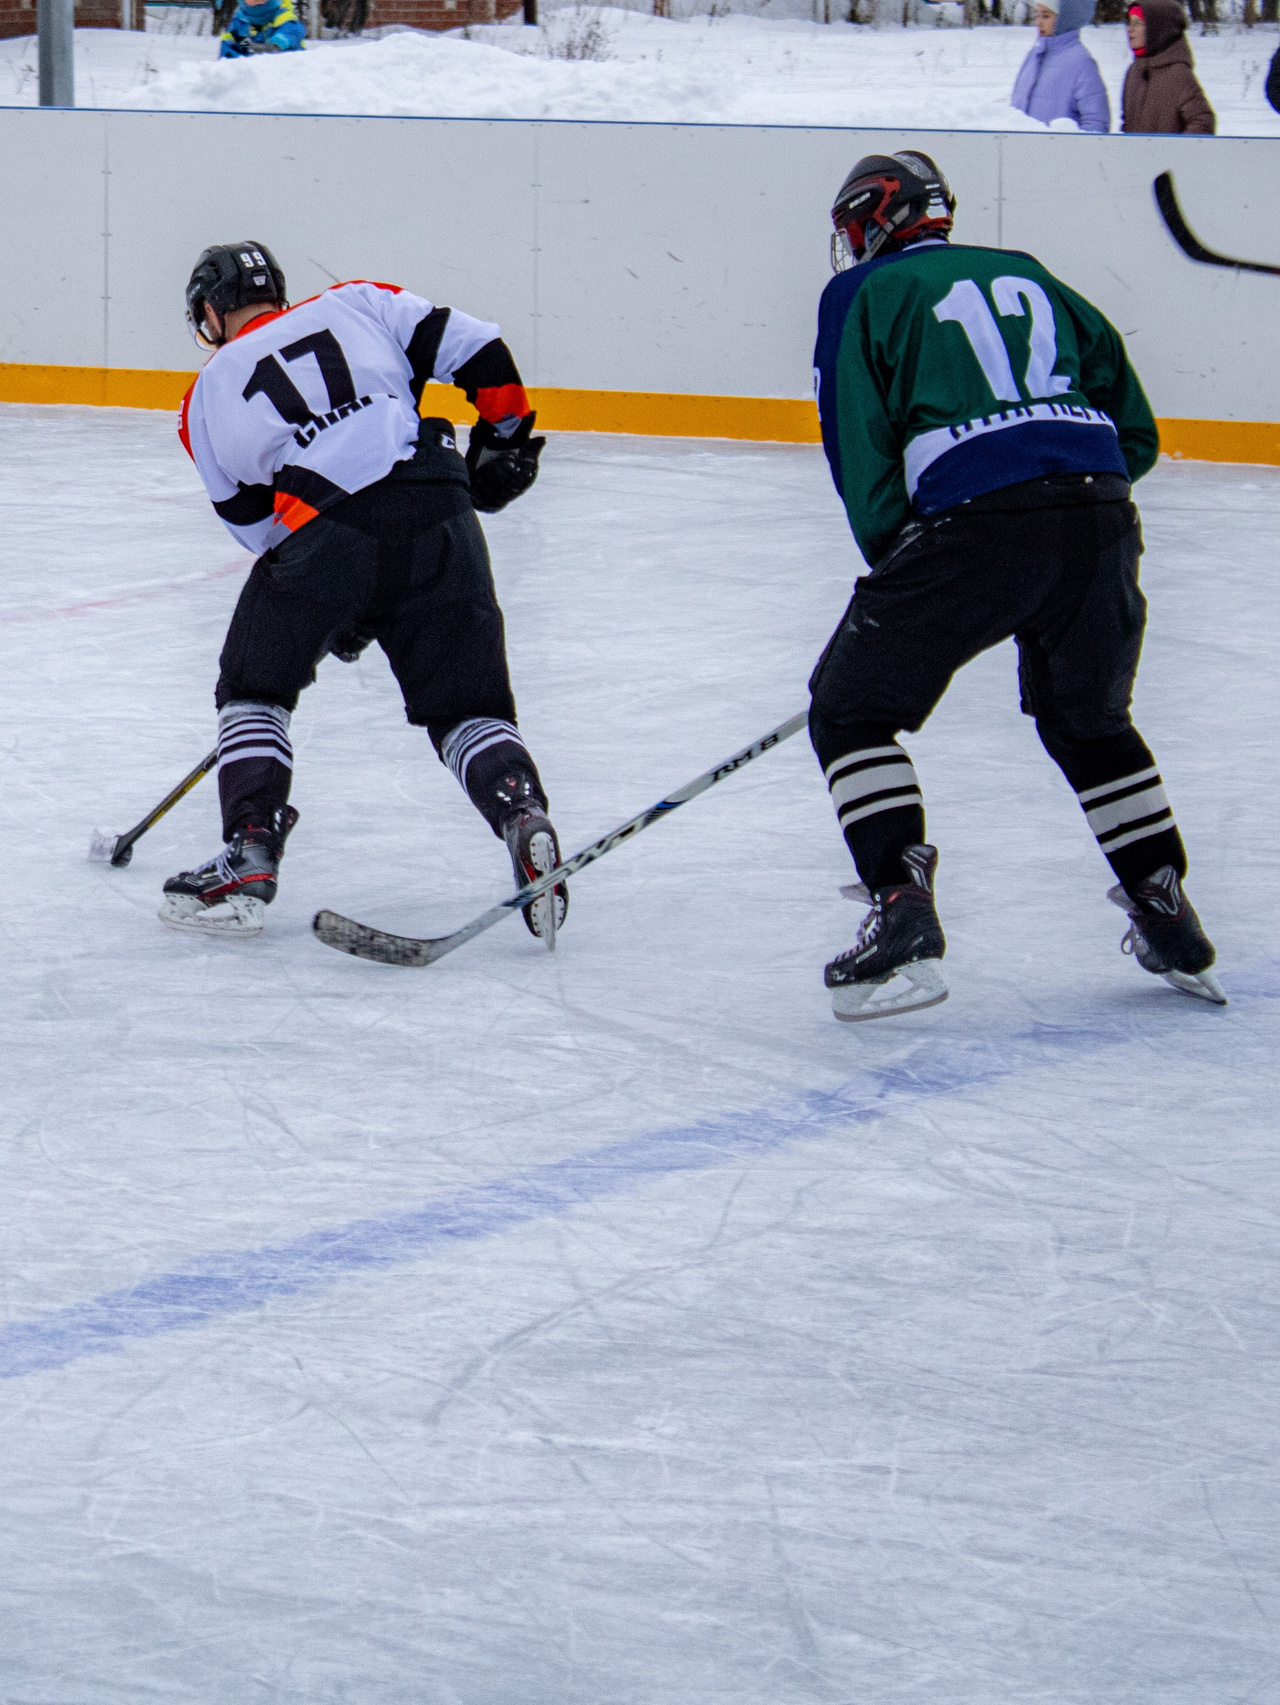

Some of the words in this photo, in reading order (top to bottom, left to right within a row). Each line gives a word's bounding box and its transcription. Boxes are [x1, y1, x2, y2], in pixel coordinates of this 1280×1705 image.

[240, 251, 267, 268] 99
[241, 328, 358, 423] 17
[932, 275, 1076, 402] 12
